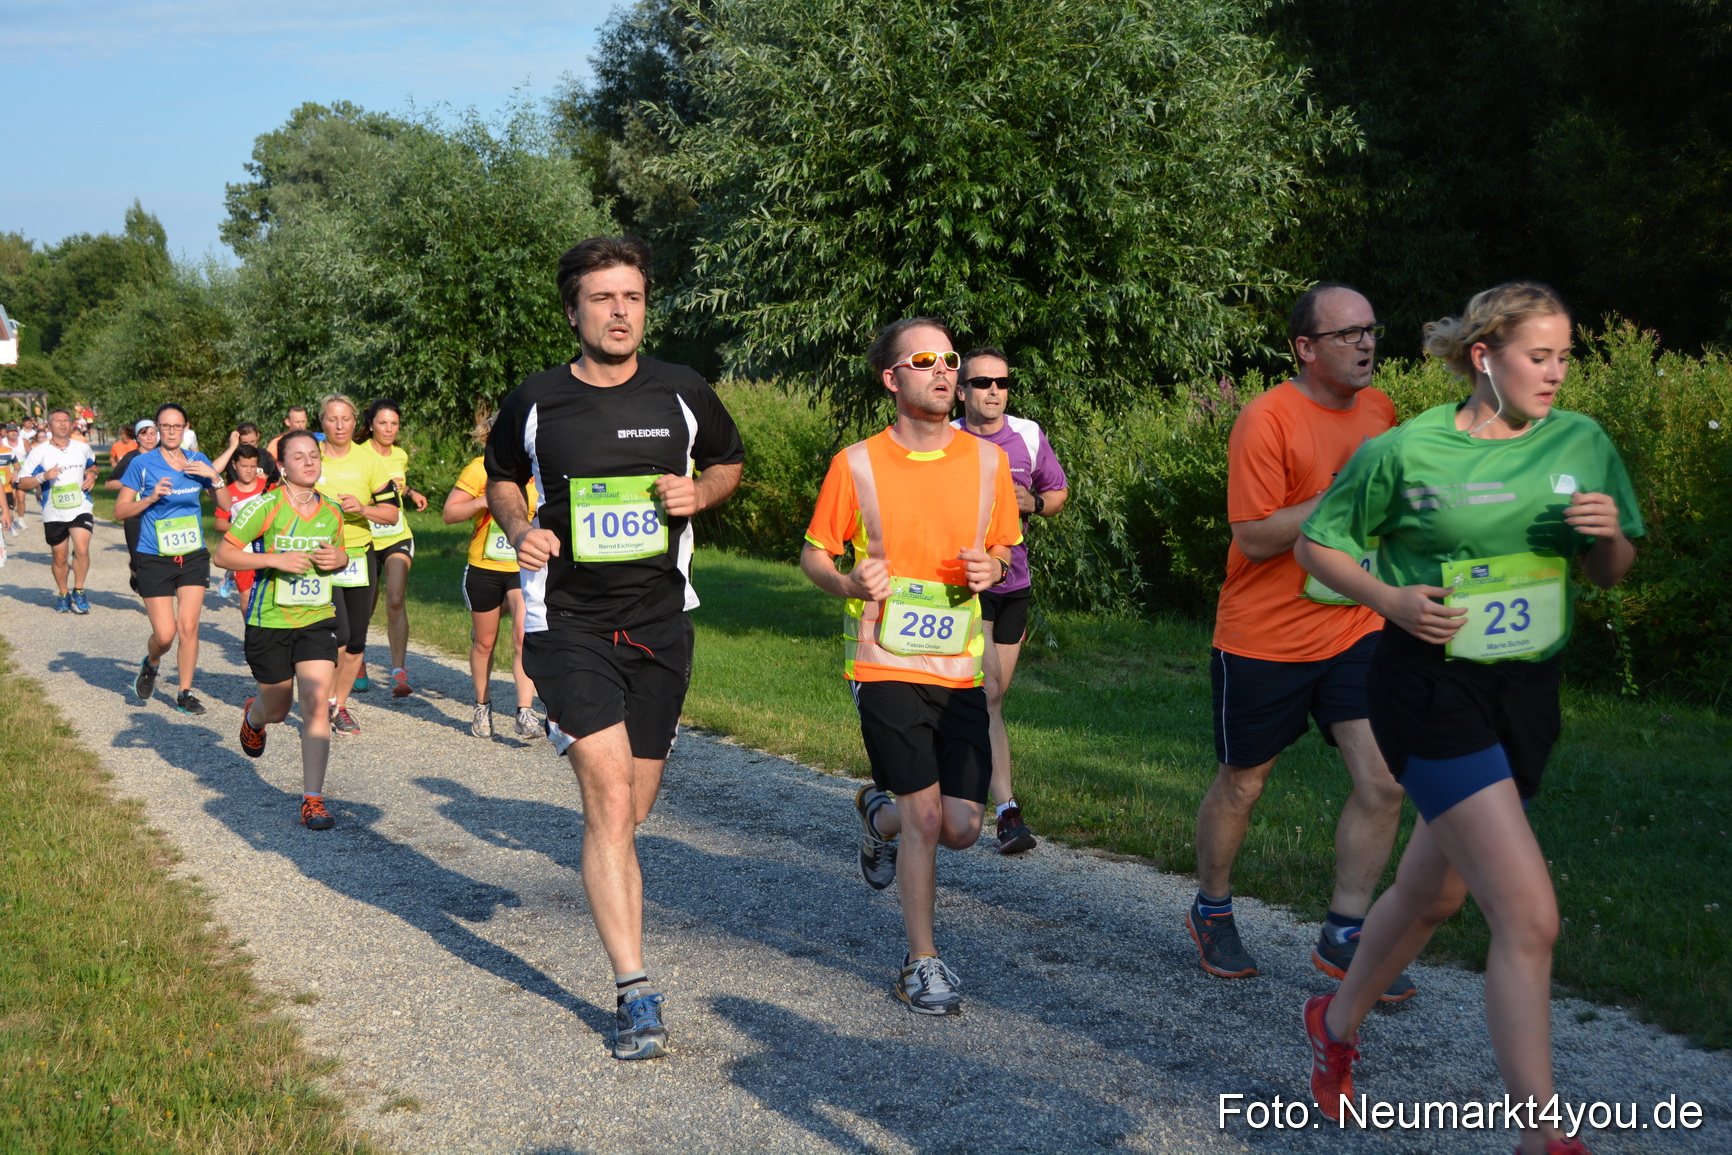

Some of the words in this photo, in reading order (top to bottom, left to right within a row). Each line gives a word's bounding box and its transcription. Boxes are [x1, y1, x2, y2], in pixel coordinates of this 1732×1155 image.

[627, 429, 670, 438] PFLEIDERER
[58, 494, 76, 503] 281
[235, 493, 276, 529] BOCK
[583, 509, 659, 538] 1068
[163, 531, 197, 547] 1313
[598, 543, 617, 551] Bernd
[617, 542, 645, 550] Eichinger
[289, 578, 320, 595] 153
[1484, 597, 1531, 636] 23
[899, 611, 955, 640] 288
[906, 641, 925, 649] Fabian
[1486, 642, 1507, 650] Marie
